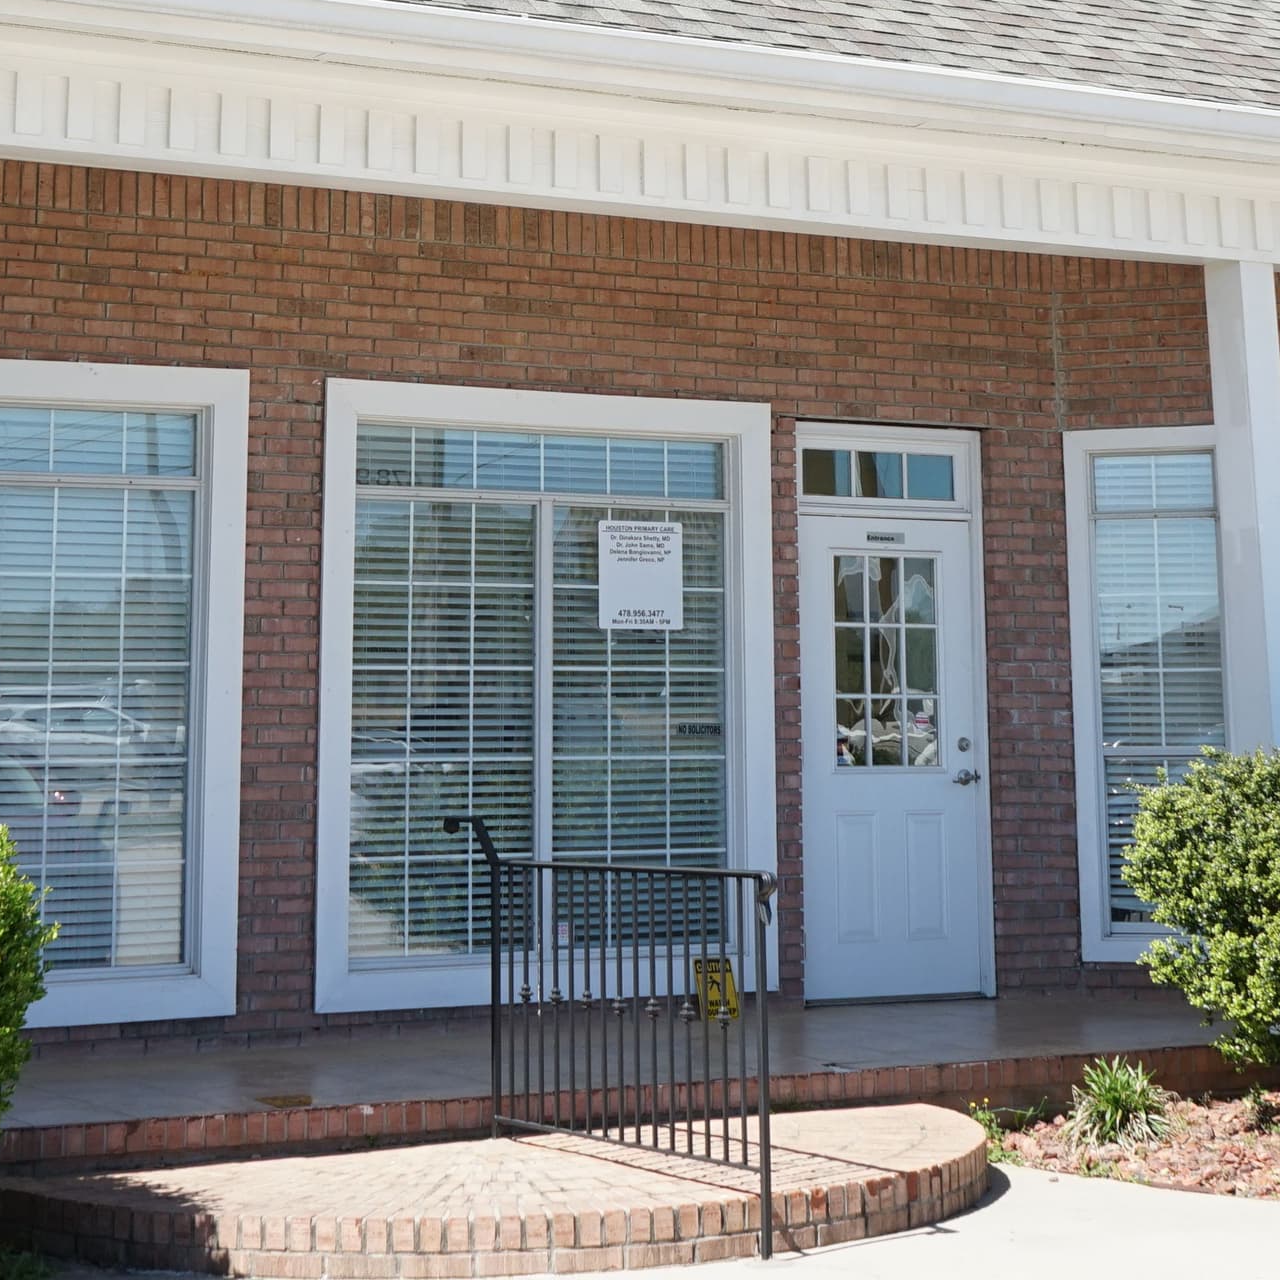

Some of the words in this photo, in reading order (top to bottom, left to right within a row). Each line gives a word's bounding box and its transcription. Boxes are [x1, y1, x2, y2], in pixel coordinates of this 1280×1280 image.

[678, 723, 687, 733] NO
[687, 724, 721, 734] SOLICITORS
[696, 961, 730, 973] CUTIN
